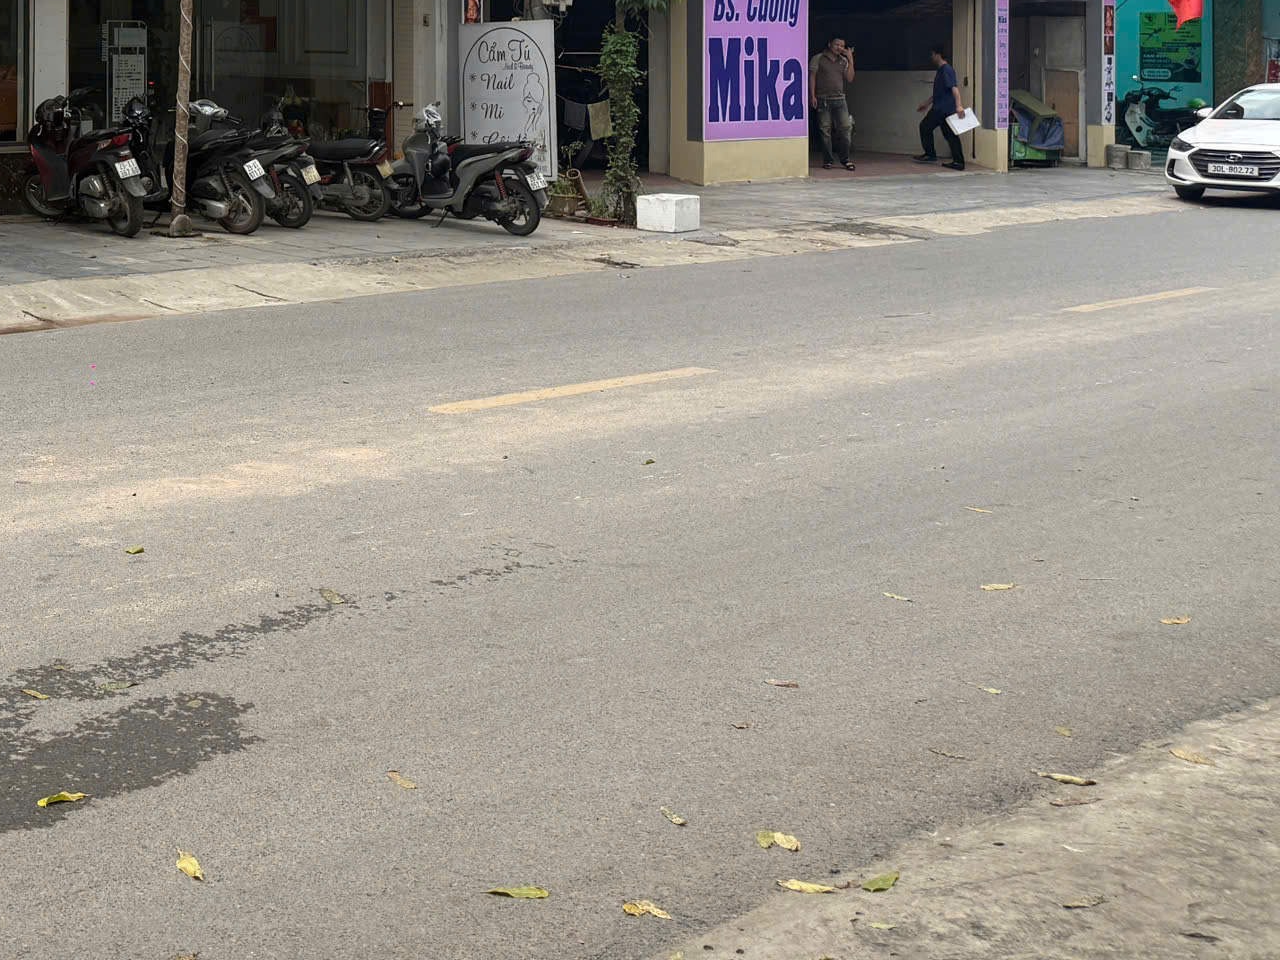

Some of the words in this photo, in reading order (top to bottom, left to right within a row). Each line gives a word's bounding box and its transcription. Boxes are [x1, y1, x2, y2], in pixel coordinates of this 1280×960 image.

[478, 40, 506, 63] Cẩm
[508, 39, 531, 62] Tú
[481, 73, 515, 90] Nail
[708, 36, 804, 122] Mika
[481, 102, 505, 120] Mi
